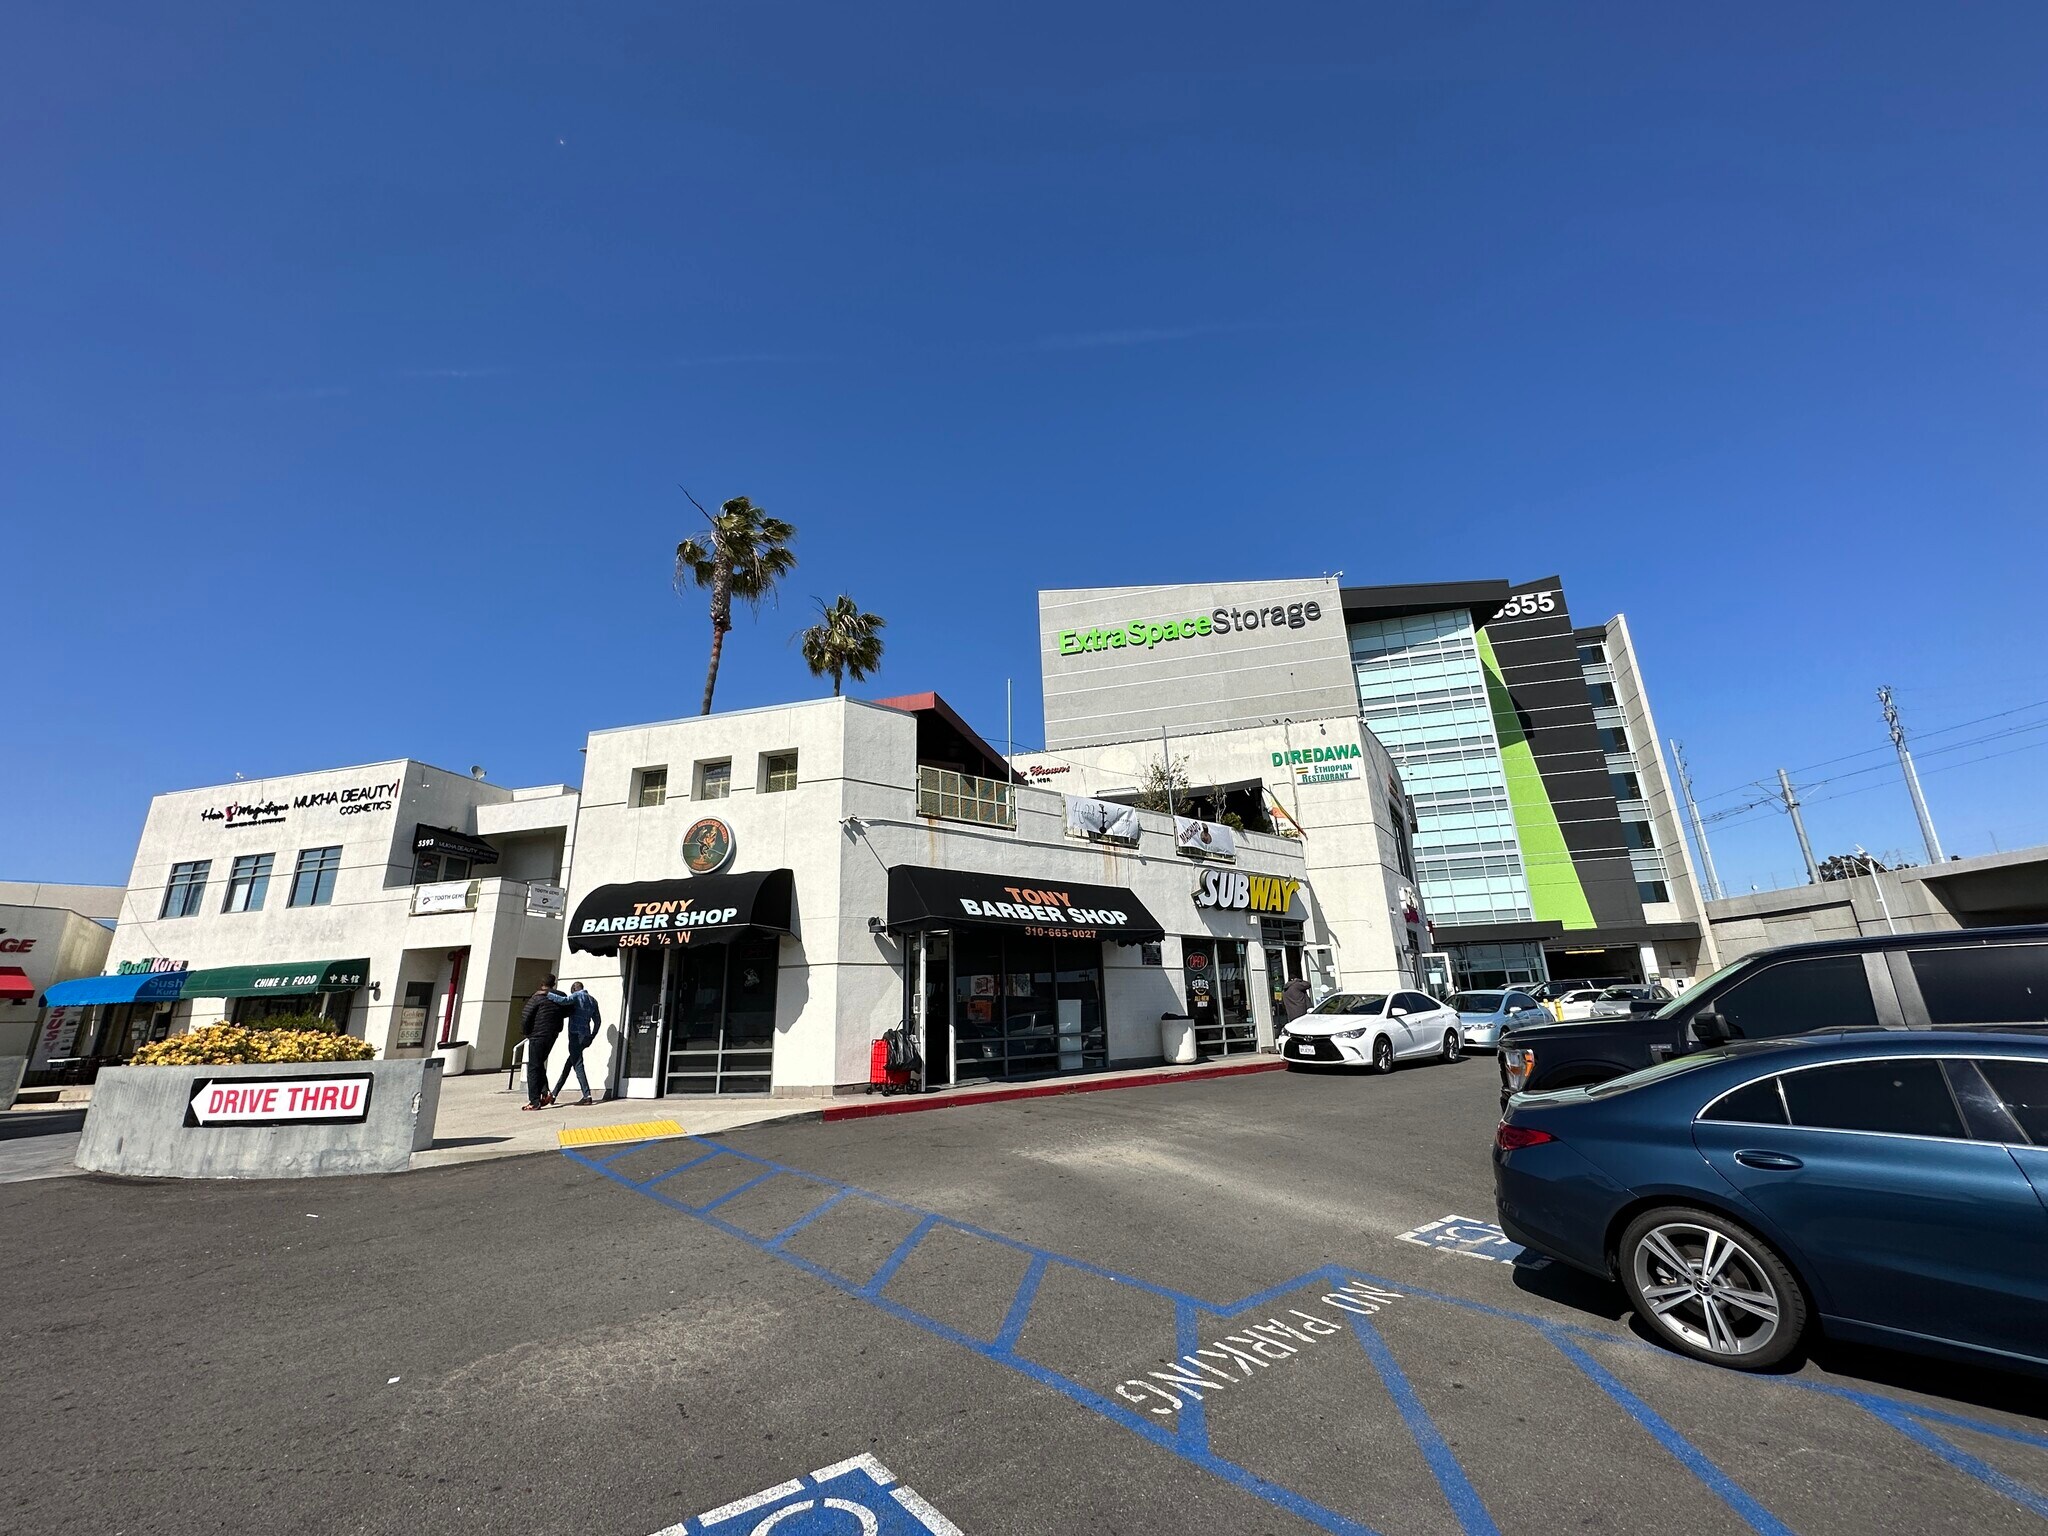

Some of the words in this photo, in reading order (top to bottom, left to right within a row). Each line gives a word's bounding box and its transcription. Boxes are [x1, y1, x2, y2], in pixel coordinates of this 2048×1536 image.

[1271, 743, 1361, 768] DIREDAWA
[294, 791, 338, 809] MUKHA
[341, 783, 396, 803] BEAUTY
[340, 801, 392, 816] COSMETICS
[417, 838, 435, 847] 5593
[1004, 887, 1072, 907] TONY
[1198, 869, 1300, 912] SUBWAY
[632, 898, 694, 916] TONY
[960, 898, 1068, 923] BARBER
[1066, 908, 1129, 926] SHOP
[581, 914, 669, 933] BARBER
[674, 907, 738, 926] SHOP
[618, 934, 650, 948] 5545
[677, 931, 691, 944] W
[1189, 955, 1205, 968] OPEN
[292, 975, 317, 986] FOOD
[156, 988, 178, 996] Kura
[208, 1088, 279, 1114] DRIVE
[288, 1085, 359, 1111] THRU
[1321, 1281, 1404, 1315] NO
[1115, 1309, 1342, 1415] PARKING
